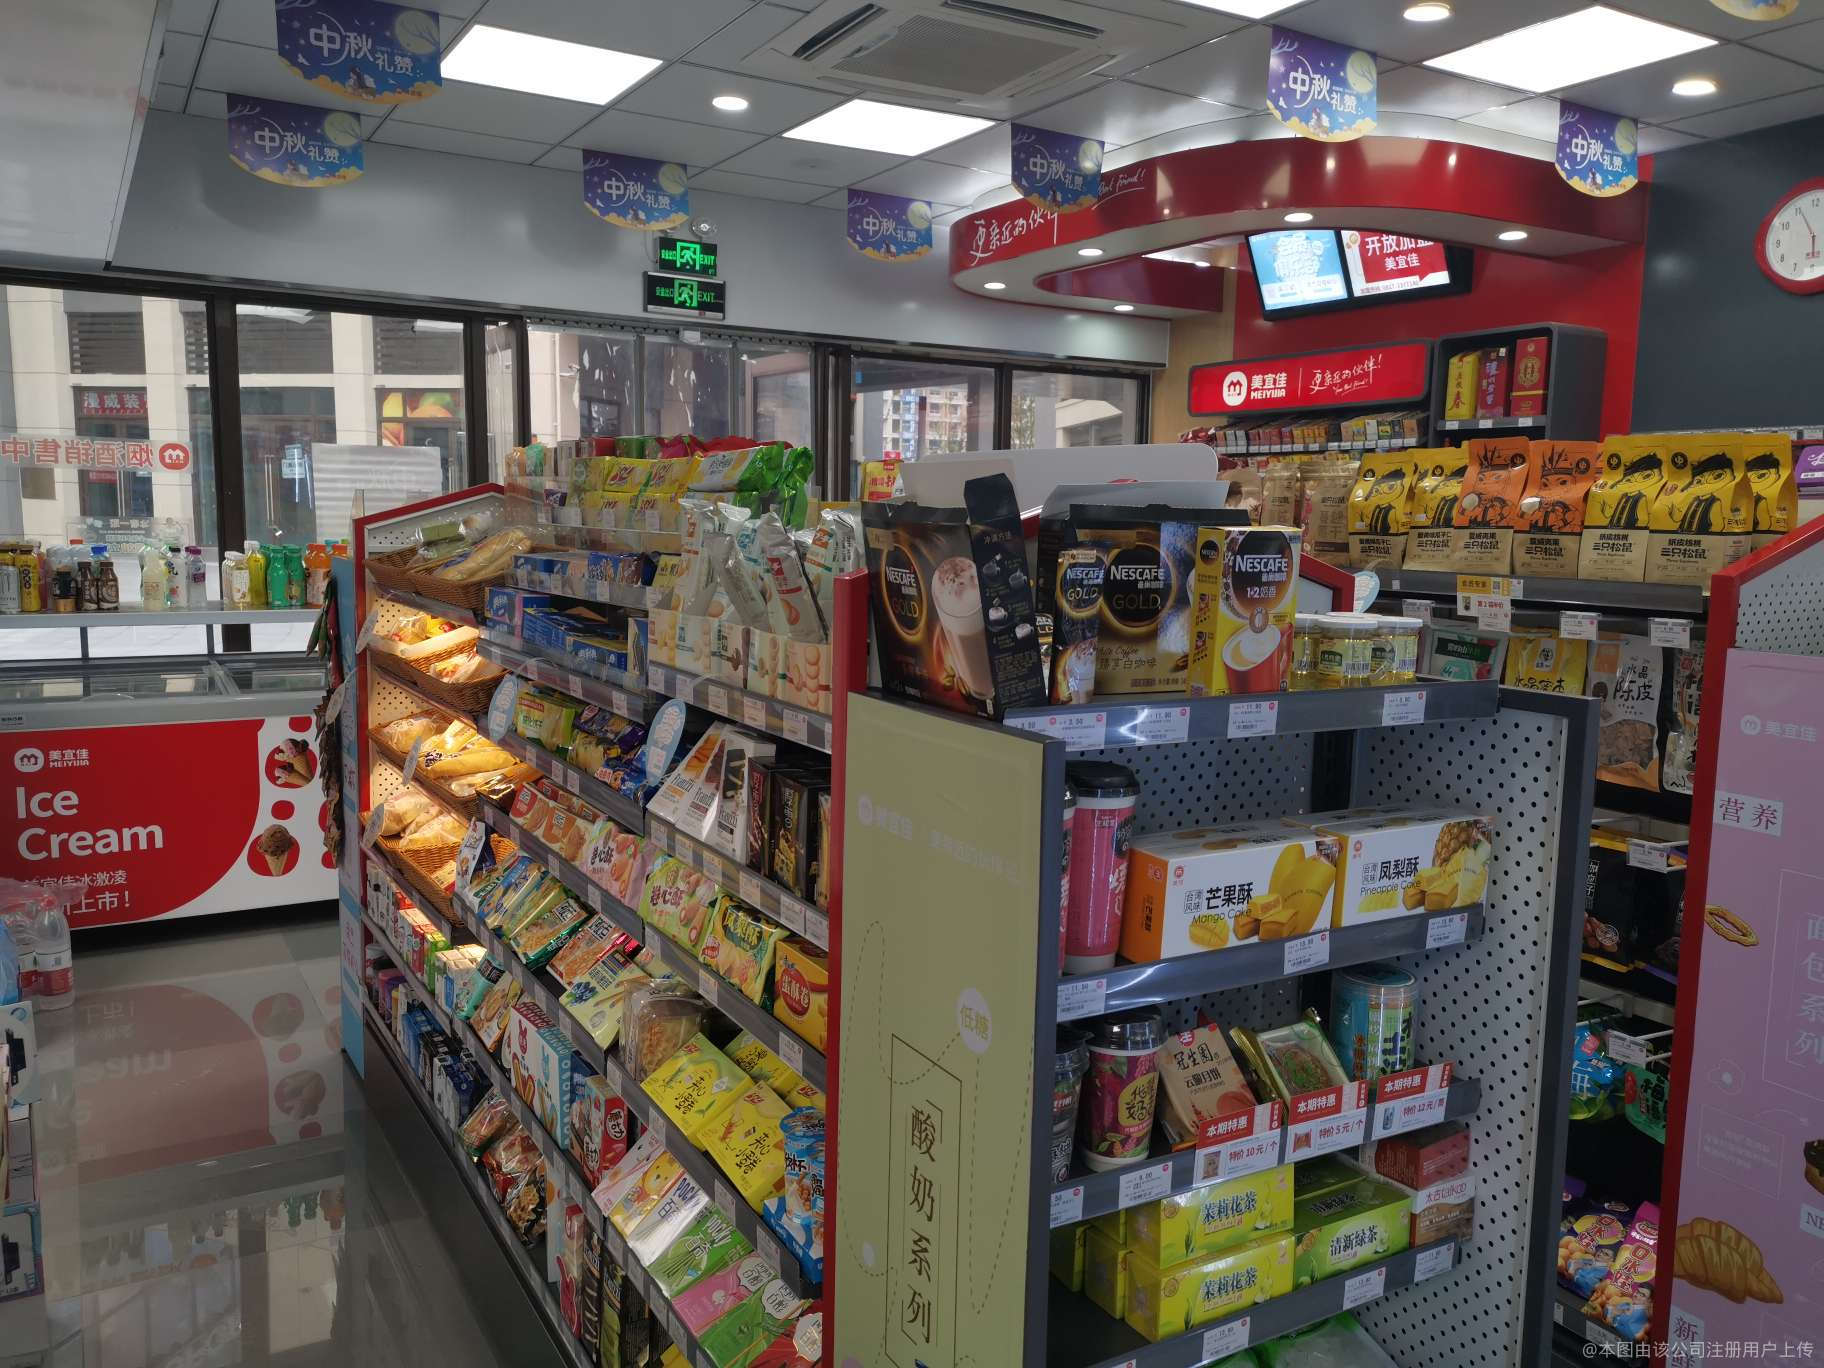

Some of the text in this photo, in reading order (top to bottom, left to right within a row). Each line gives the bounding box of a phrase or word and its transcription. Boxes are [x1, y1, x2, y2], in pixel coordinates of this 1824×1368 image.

[309, 24, 372, 61] 中秋
[374, 53, 413, 75] 礼赞
[1289, 68, 1330, 101] 中秋
[1330, 93, 1357, 113] 礼赞
[254, 127, 306, 153] 中秋
[1571, 134, 1603, 164] 中秋
[1030, 154, 1064, 179] 中秋
[1603, 154, 1623, 172] 礼赞
[603, 178, 645, 201] 中秋
[1811, 198, 1821, 208] 12
[863, 214, 896, 236] 中秋
[1782, 222, 1790, 230] 10
[1776, 240, 1782, 248] 9
[700, 254, 715, 266] EXIT
[1385, 252, 1421, 271] 美宜佳
[1780, 254, 1786, 262] 8
[1793, 263, 1799, 272] 7
[698, 290, 715, 303] EXIT
[1251, 371, 1287, 389] 美宜佳
[84, 392, 149, 409] 漫威装
[1464, 541, 1500, 550] 三只松鼠
[1524, 546, 1564, 558] 三只松鼠
[1593, 542, 1633, 553] 三只松鼠
[1661, 547, 1707, 560] 三只松鼠
[1067, 587, 1099, 601] GOLD
[1113, 593, 1161, 611] GOLD
[1623, 663, 1649, 679] 水晶
[1614, 678, 1655, 701] 陈皮
[1763, 723, 1818, 743] 美宜佳
[48, 748, 89, 761] 美宜佳
[16, 786, 80, 819] Ice
[1719, 798, 1780, 831] 营养
[17, 823, 163, 861] Cream
[1378, 856, 1421, 882] 凤梨酥
[1206, 882, 1254, 911] 芒果酥
[1360, 878, 1422, 897] Pineapple Cake
[66, 890, 130, 917] 上市!
[1184, 901, 1202, 914] 风味
[1192, 905, 1253, 926] Mango Cake
[958, 1002, 991, 1043] 低糖
[1173, 1045, 1215, 1073] 冠生园
[1384, 1073, 1422, 1094] 本期特惠
[1297, 1093, 1337, 1115] 本期特惠
[1206, 1115, 1249, 1138] 本期特惠
[1201, 1192, 1259, 1226] 茉莉花茶
[908, 1104, 937, 1347] 酸奶系列
[1329, 1223, 1379, 1257] 清新绿茶
[1201, 1268, 1259, 1301] 茉莉花茶
